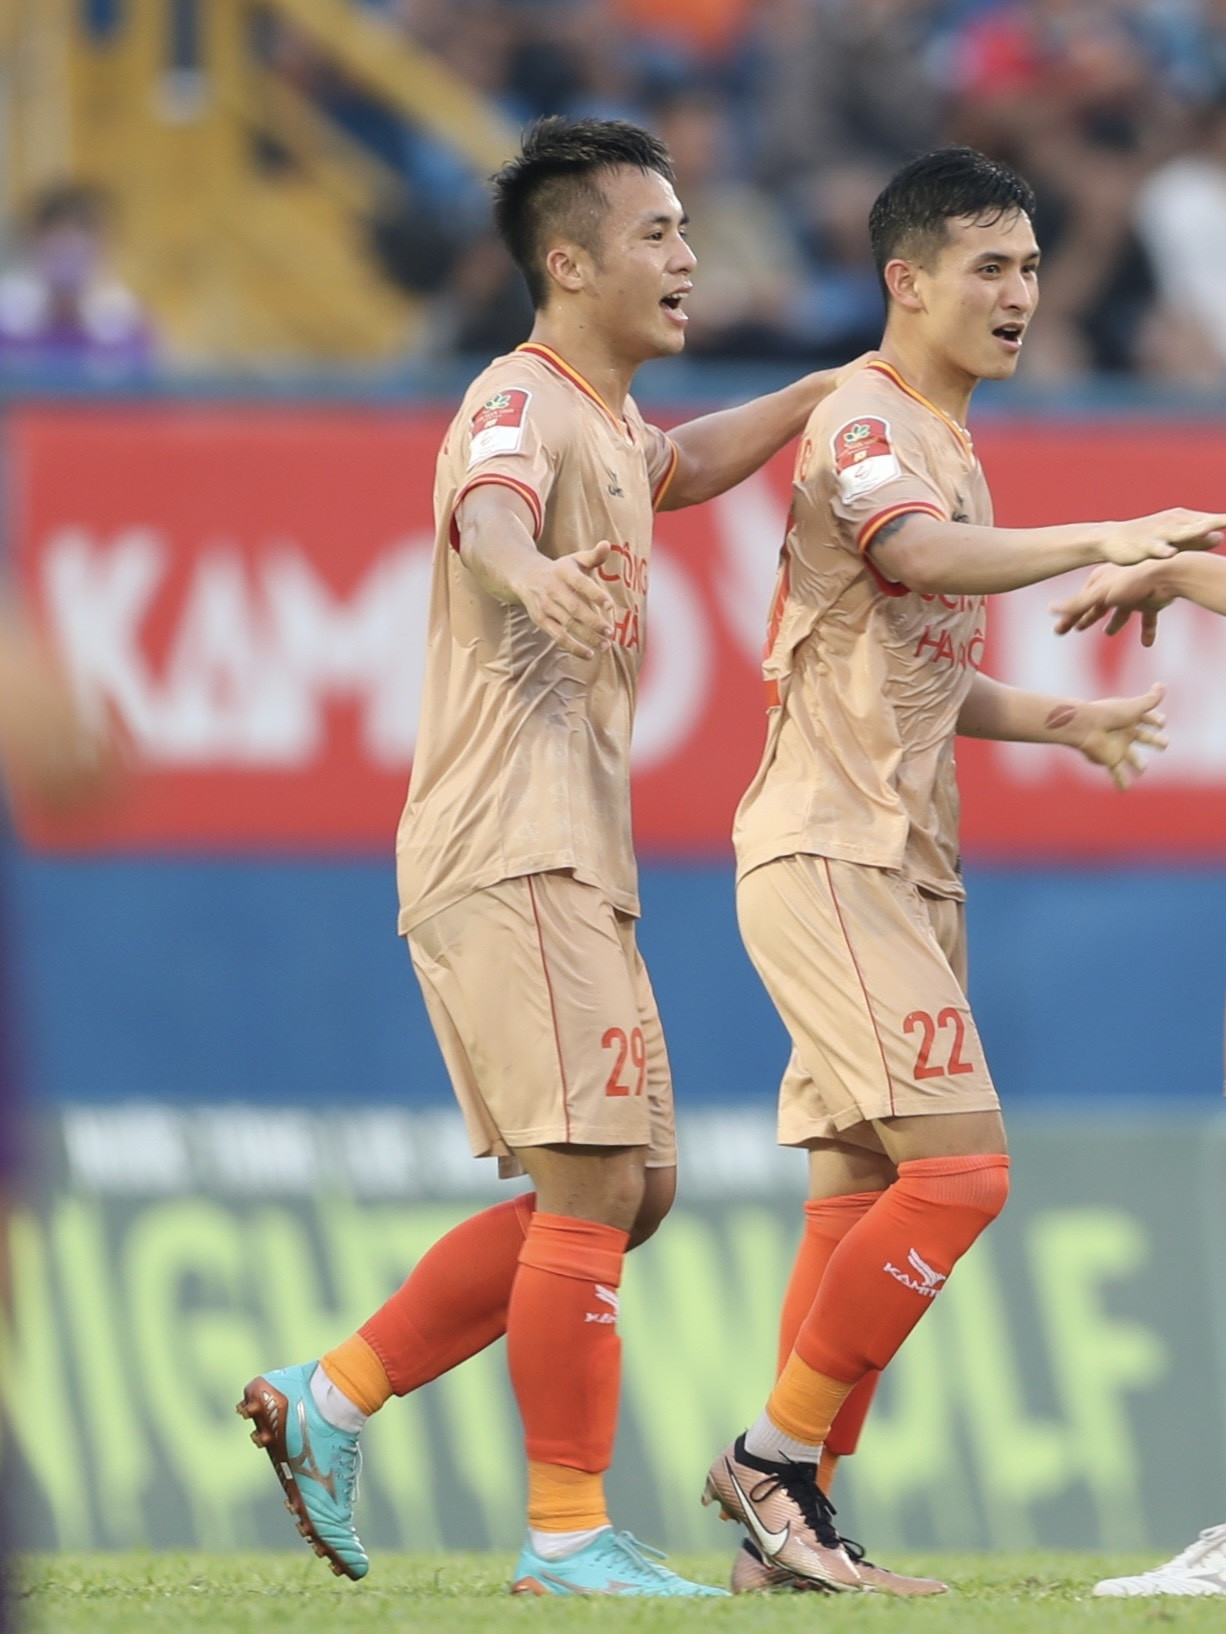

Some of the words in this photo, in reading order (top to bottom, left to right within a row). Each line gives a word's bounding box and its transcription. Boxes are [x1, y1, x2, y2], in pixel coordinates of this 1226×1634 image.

[601, 1026, 647, 1098] 29
[902, 1007, 974, 1081] 22
[882, 1261, 938, 1298] KAMIT
